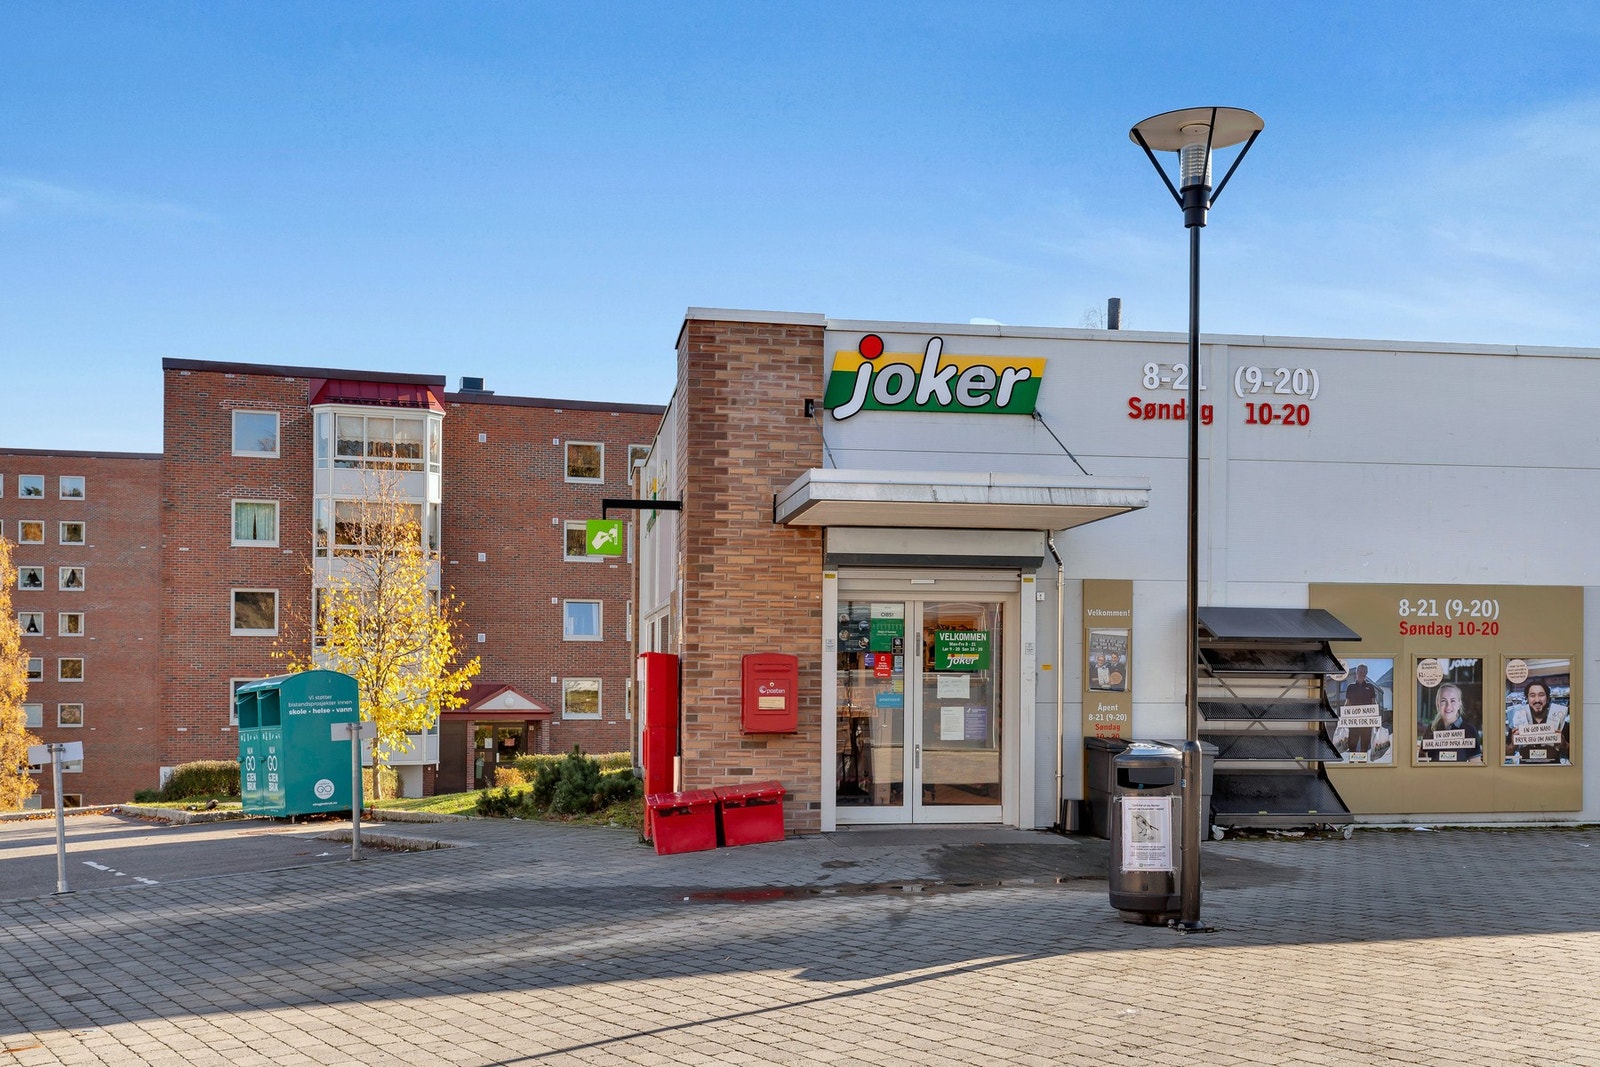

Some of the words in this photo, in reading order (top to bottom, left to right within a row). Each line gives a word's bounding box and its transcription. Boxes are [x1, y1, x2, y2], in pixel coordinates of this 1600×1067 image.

[832, 334, 1032, 421] joker
[1234, 366, 1320, 400] (9-20)
[1128, 396, 1213, 425] Søndg
[1245, 402, 1310, 426] 10-20
[1087, 609, 1131, 617] Velkommen!
[1399, 598, 1439, 617] 8-21
[1445, 599, 1500, 620] (9-20)
[939, 632, 987, 641] VELKOMMEN
[1399, 621, 1452, 638] Søndag
[1458, 621, 1499, 636] 10-20
[946, 653, 978, 668] joker
[1449, 658, 1478, 671] joker
[1098, 702, 1118, 712] Åpent
[246, 755, 256, 771] GO
[267, 755, 278, 771] GO
